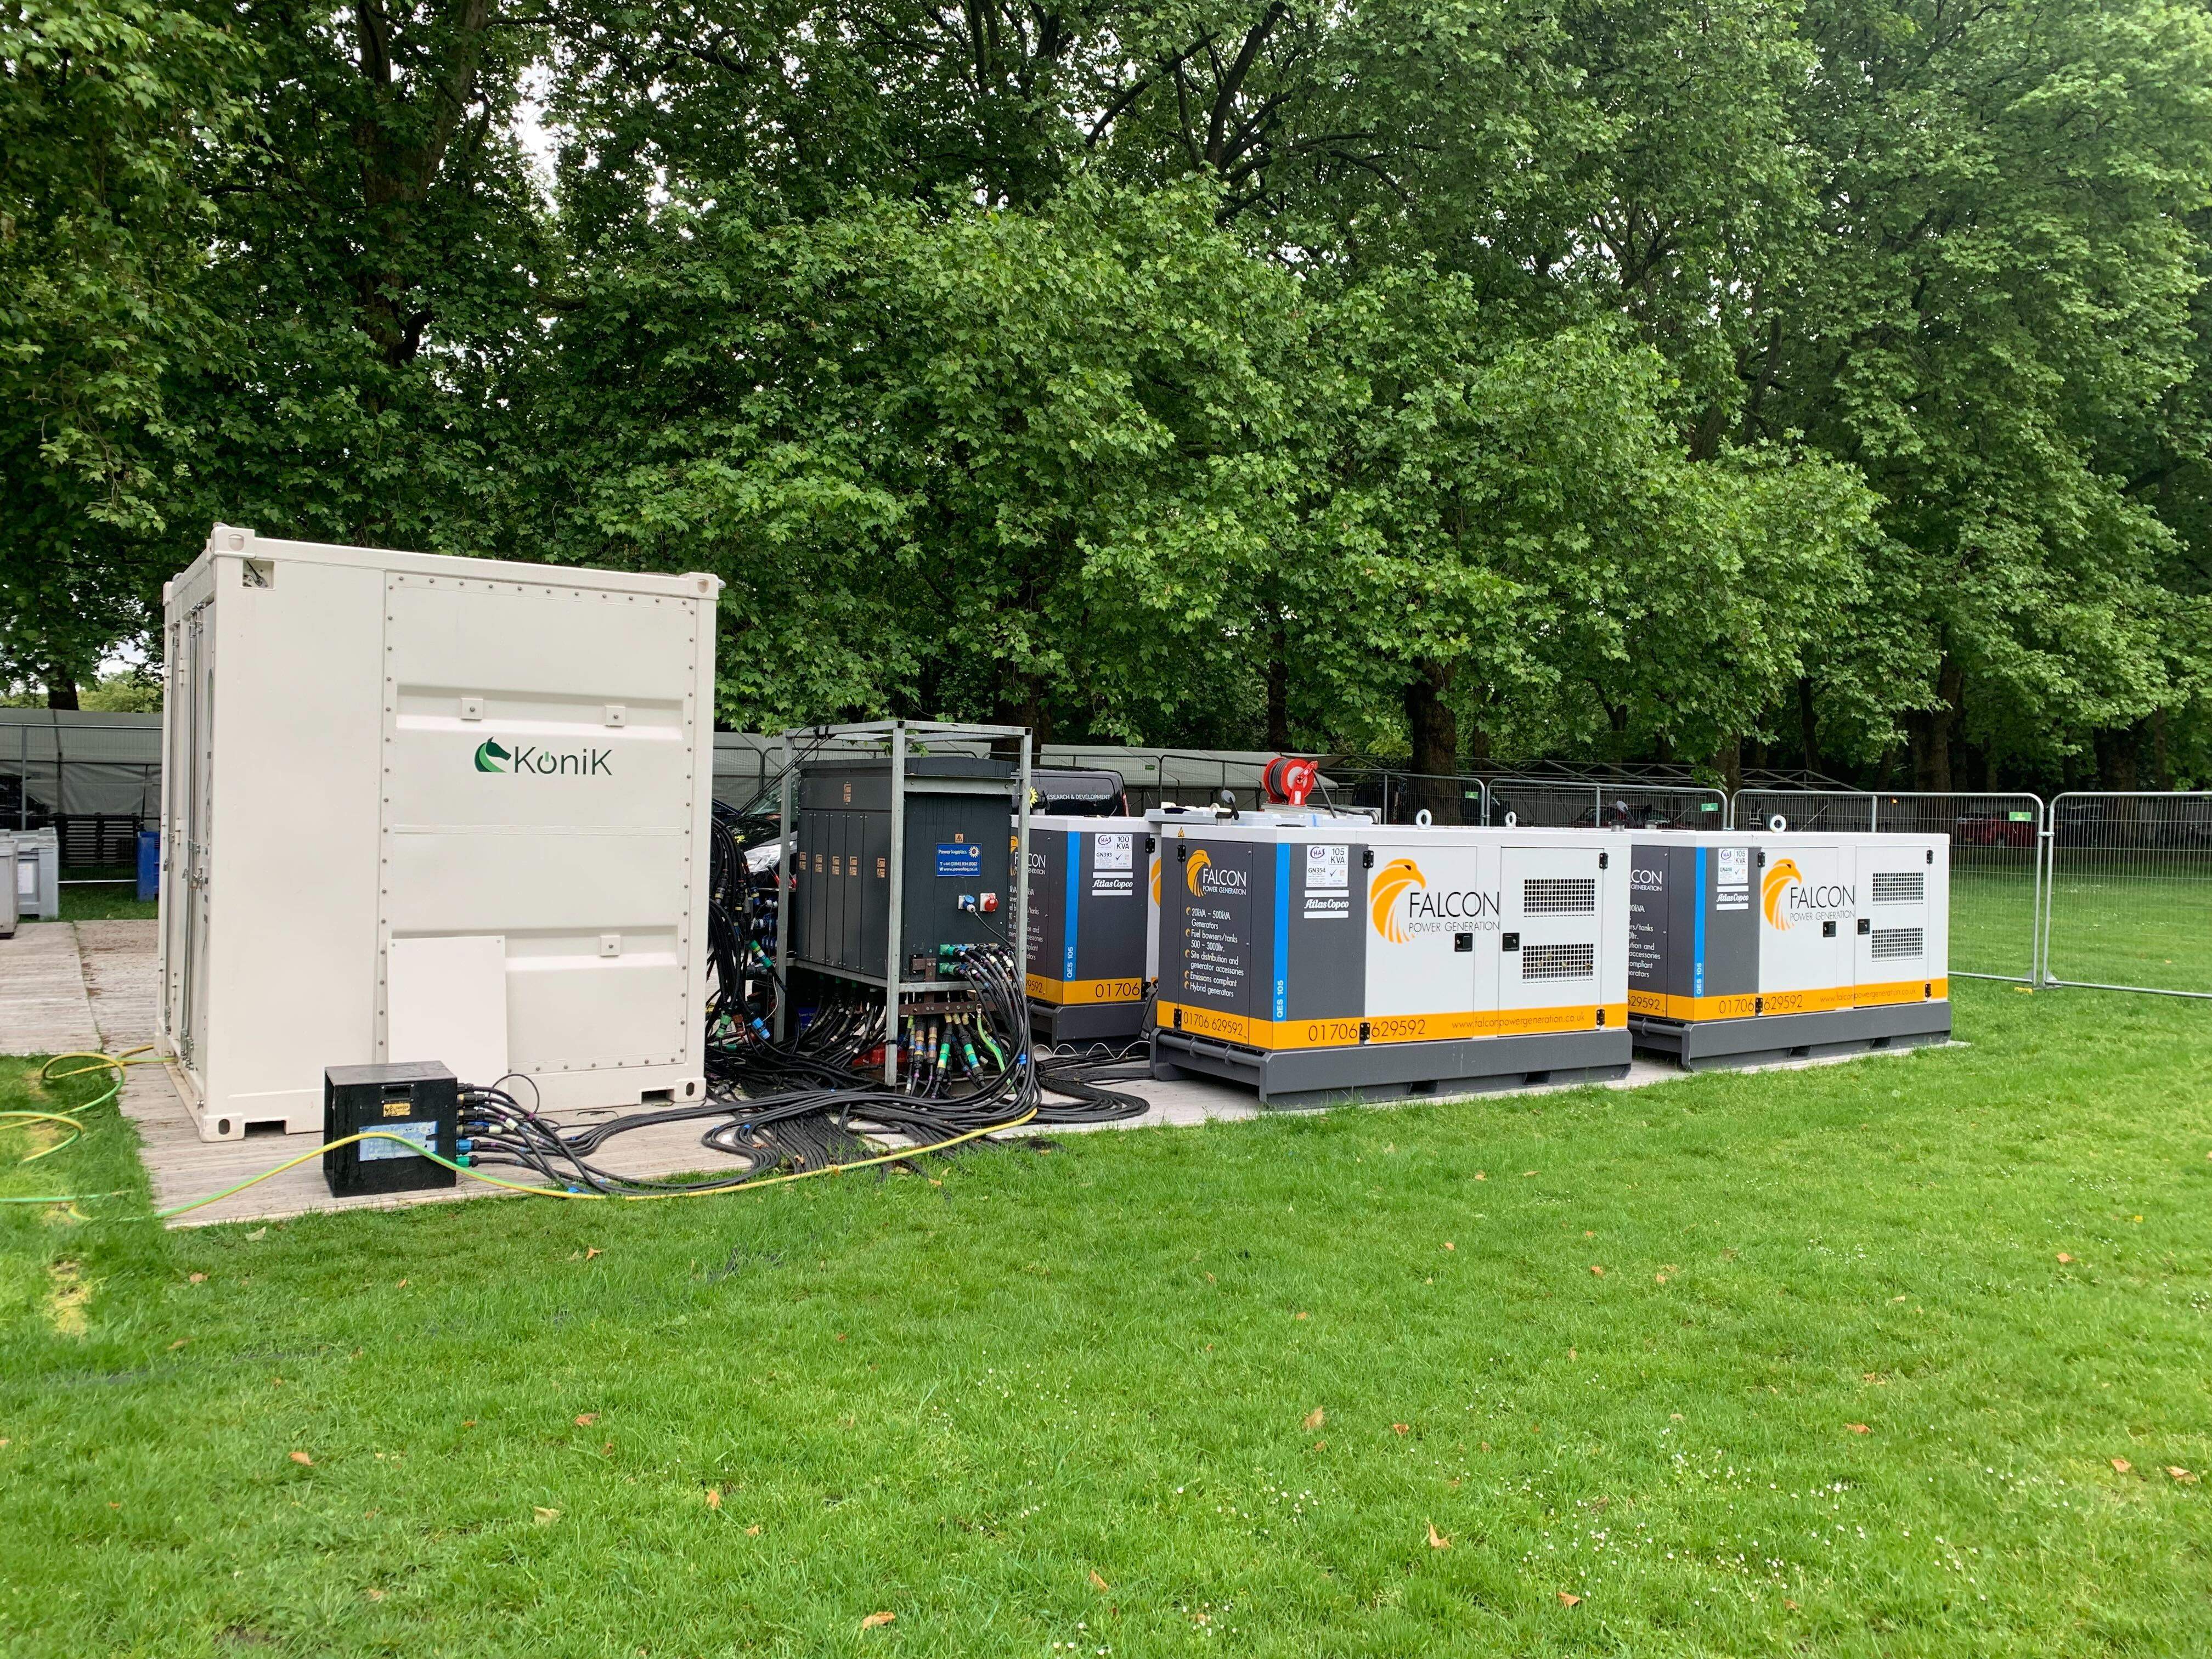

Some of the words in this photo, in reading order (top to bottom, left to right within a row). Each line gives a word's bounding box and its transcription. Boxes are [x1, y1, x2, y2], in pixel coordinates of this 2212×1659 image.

[1098, 834, 1111, 845] CHAS
[1310, 847, 1325, 859] CHAS
[1092, 879, 1113, 888] Atlas
[1113, 879, 1133, 889] Copco
[1203, 868, 1246, 888] FALCON
[1630, 869, 1662, 885] CON
[1218, 887, 1246, 895] GENERATION
[1716, 893, 1733, 902] Atlas
[1733, 893, 1749, 903] Copco
[1790, 885, 1855, 909] FALCON
[1304, 899, 1327, 909] Atlas
[1327, 899, 1349, 910] Copco
[1410, 891, 1499, 918] FALCON
[1192, 907, 1206, 917] 20kVA
[1212, 910, 1231, 921] 500kVA
[1790, 912, 1813, 921] POWER
[1815, 910, 1855, 921] GENERATION
[1191, 918, 1218, 929] Generators
[1409, 922, 1441, 933] POWER
[1444, 921, 1500, 932] GENERATION
[1191, 928, 1201, 938] Fuel
[1202, 929, 1238, 943] bowsers/tanks
[1191, 939, 1200, 949] 500
[1206, 942, 1225, 952] 3000ltr.
[1190, 950, 1200, 960] Site
[1201, 951, 1227, 963] distribution
[1228, 956, 1239, 966] and
[1629, 960, 1653, 969] ompliant
[1190, 962, 1214, 971] generator
[1215, 966, 1244, 977] accessories
[1026, 978, 1043, 994] 9592
[1190, 971, 1212, 983] Emissions
[1213, 976, 1237, 987] compliant
[1095, 982, 1140, 998] 01706
[1190, 981, 1206, 992] Hybrid
[1207, 988, 1234, 997] generators
[1719, 998, 1754, 1014] 01706
[1764, 995, 1803, 1011] 629592
[1183, 1011, 1210, 1029] 01706
[1212, 1019, 1243, 1036] 629592
[1452, 1012, 1585, 1029] www.falconpowergeneration.co.uk
[1308, 1023, 1358, 1041] 01706
[1371, 1019, 1425, 1038] 629592
